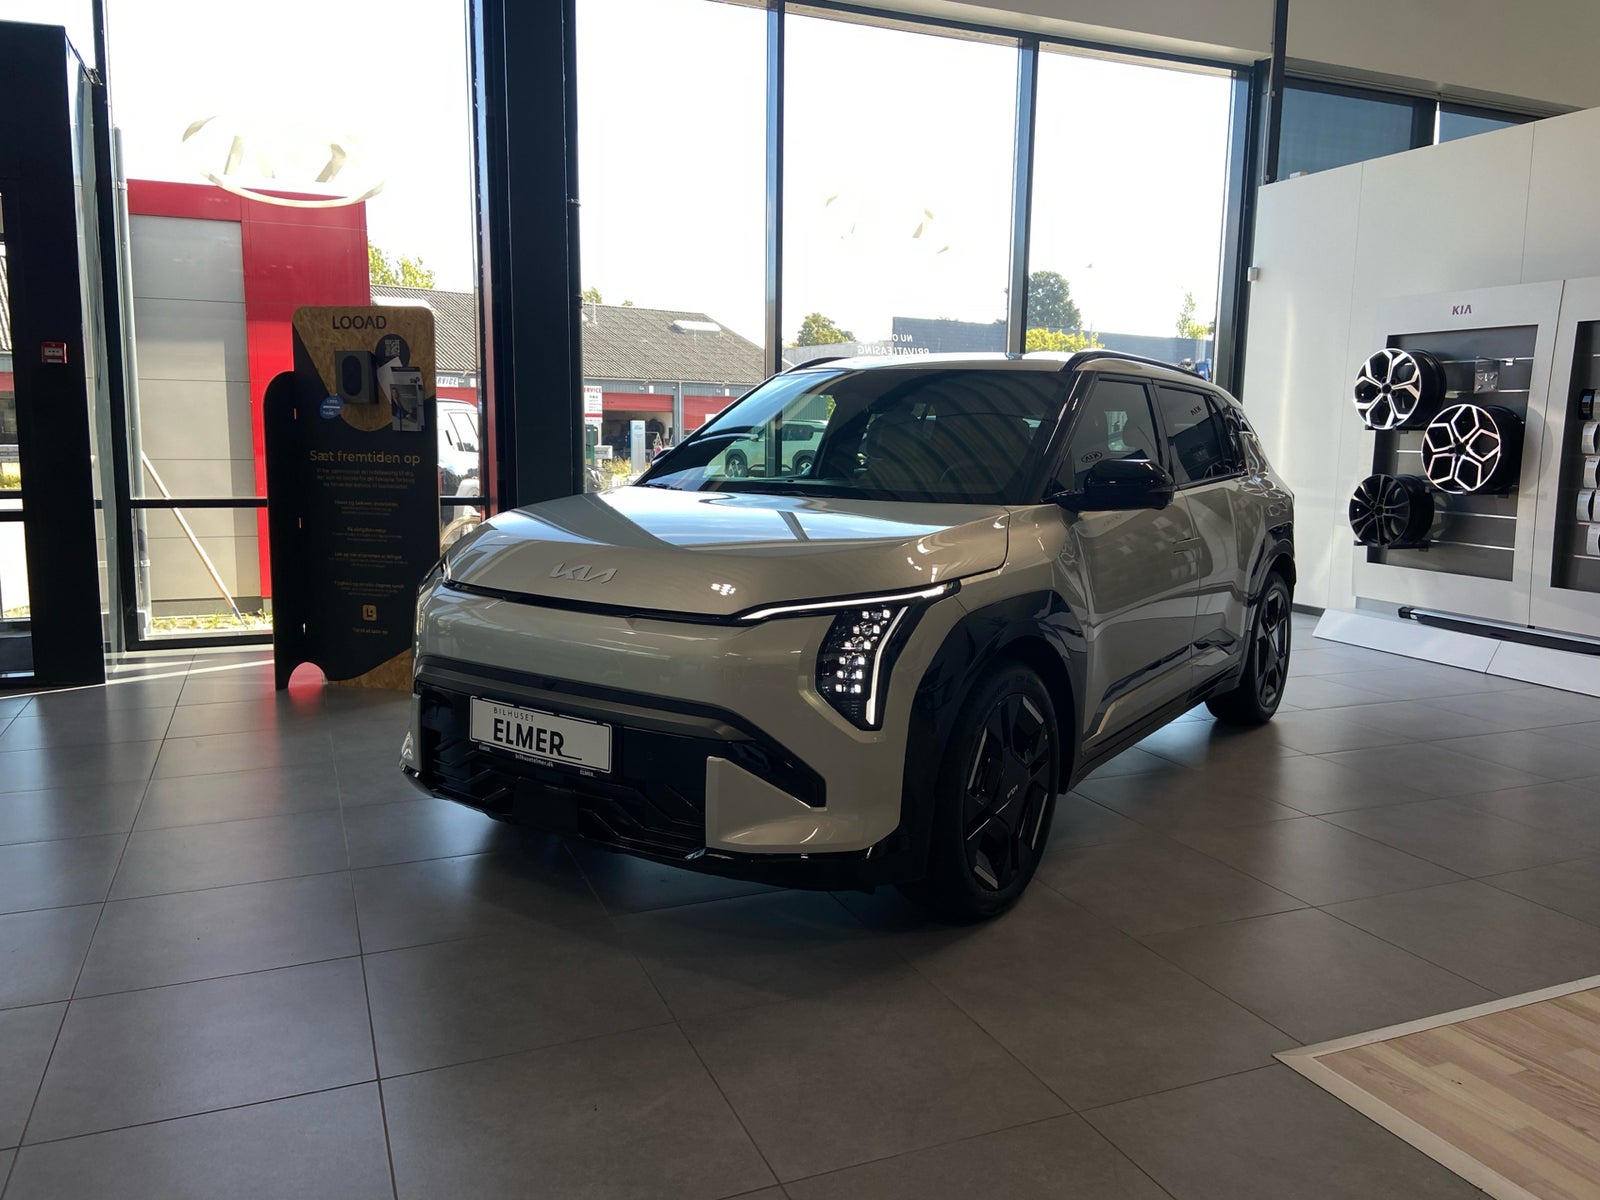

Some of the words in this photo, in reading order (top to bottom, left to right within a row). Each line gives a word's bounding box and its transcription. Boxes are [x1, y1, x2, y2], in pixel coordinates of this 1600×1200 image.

[1451, 304, 1472, 316] KIA
[332, 315, 387, 330] LOOAD
[309, 449, 334, 462] Sæt
[337, 450, 401, 463] fremtiden
[403, 453, 421, 466] op
[493, 706, 535, 722] BILHUSET
[493, 718, 565, 756] ELMER
